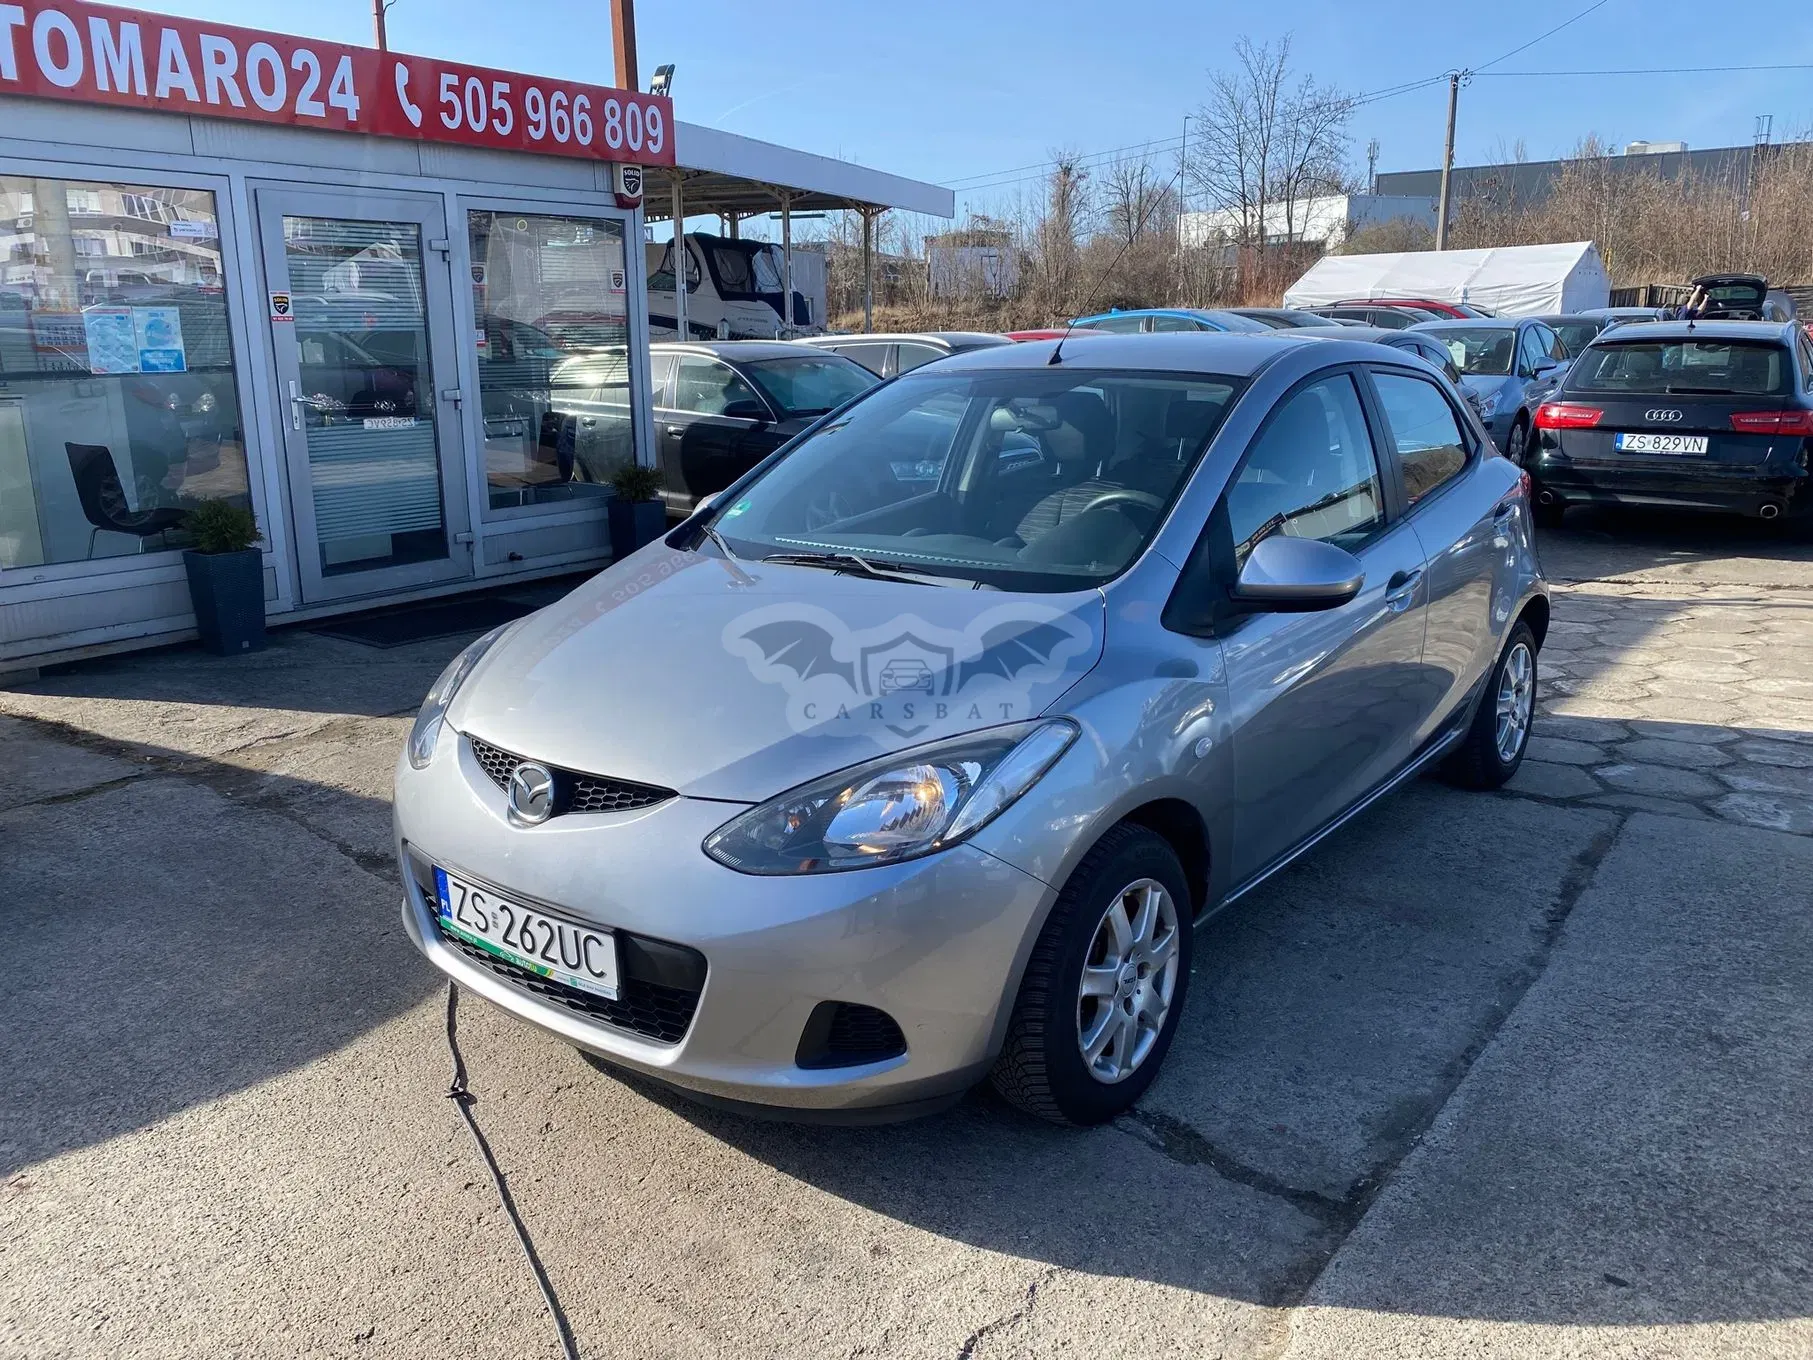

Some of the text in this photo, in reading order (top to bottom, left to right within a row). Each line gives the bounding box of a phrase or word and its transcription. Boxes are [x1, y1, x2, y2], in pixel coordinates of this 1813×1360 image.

[438, 72, 514, 136] 505
[524, 86, 594, 146] 966
[603, 98, 664, 154] 809
[623, 169, 641, 177] SOLID
[1626, 435, 1704, 452] ZS 829VN
[441, 898, 451, 913] PL
[452, 881, 607, 979] ZS 262UC
